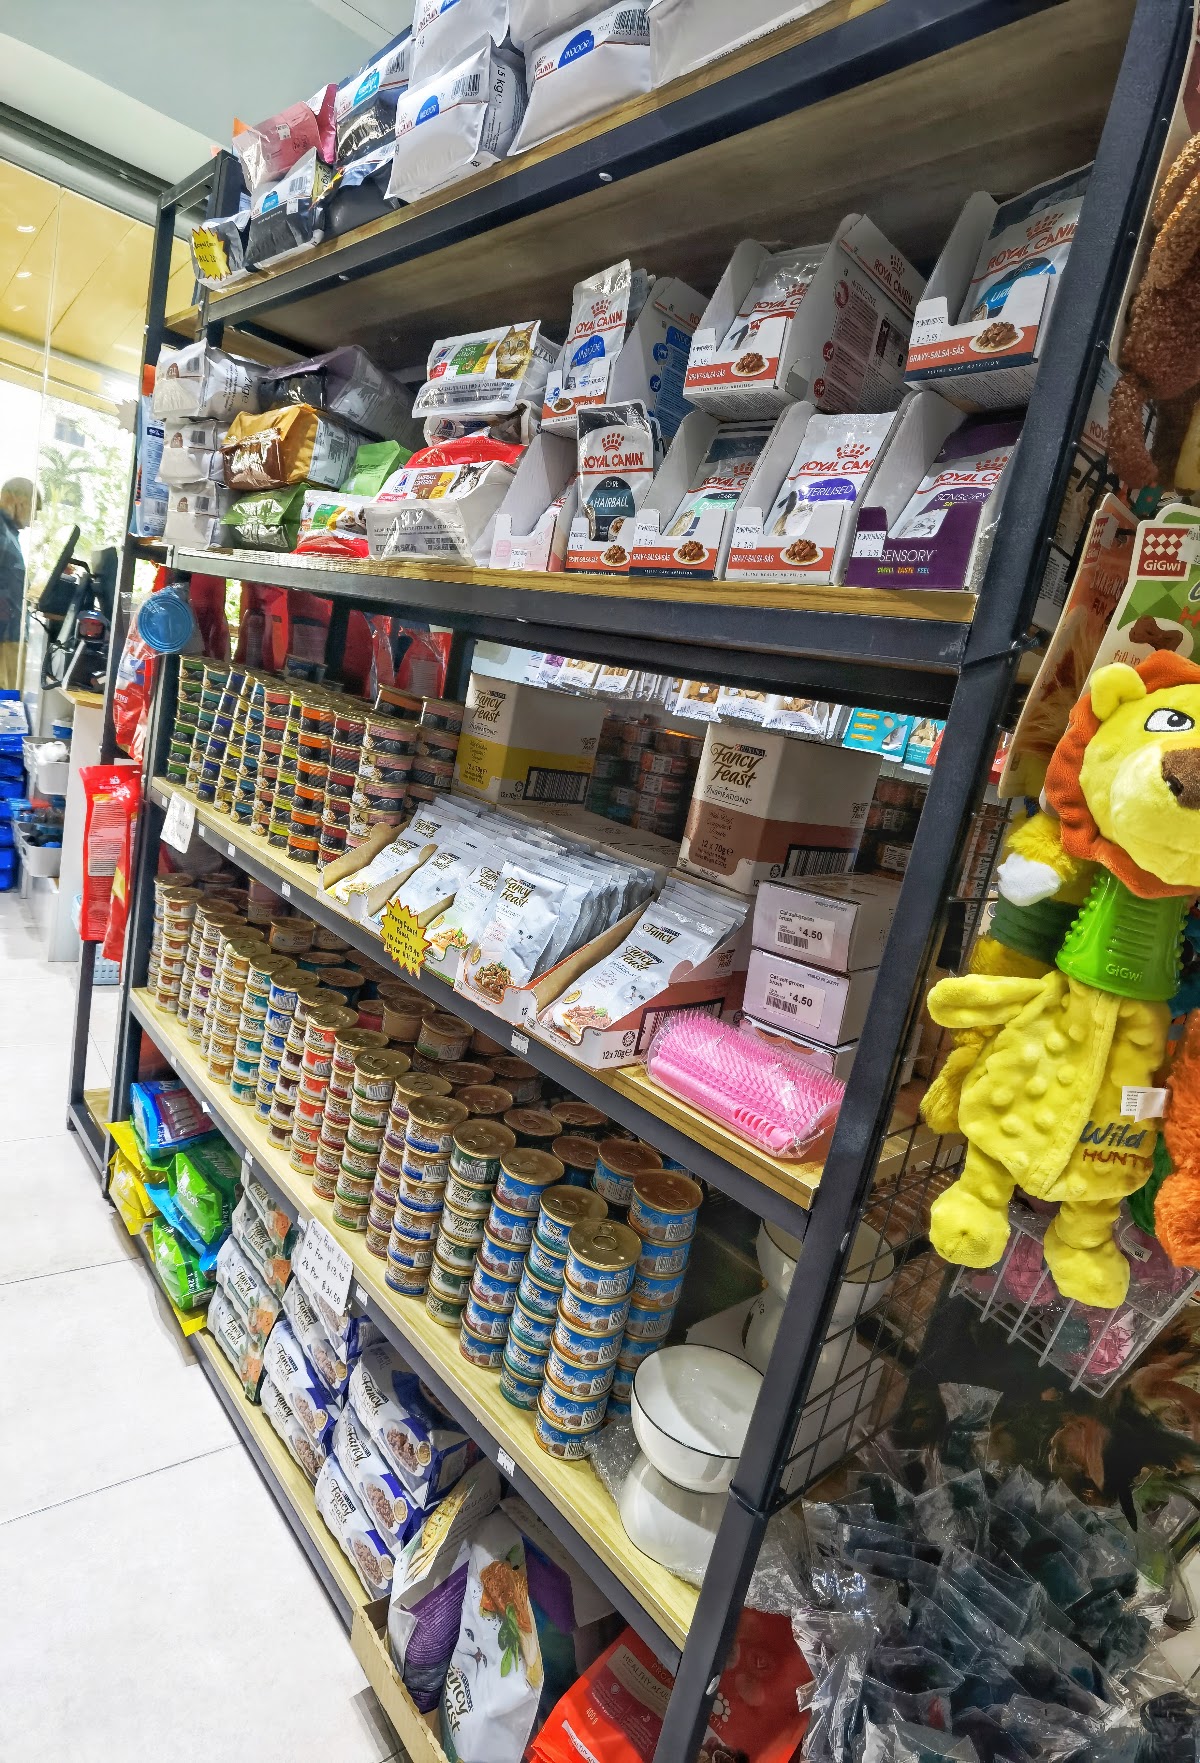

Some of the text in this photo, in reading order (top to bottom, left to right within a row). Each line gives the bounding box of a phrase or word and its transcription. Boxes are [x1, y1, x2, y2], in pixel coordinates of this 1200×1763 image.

[988, 243, 1030, 270] ROYAL
[874, 259, 892, 286] ROYAL
[991, 286, 1011, 303] LIGH
[753, 300, 788, 310] ROYAL
[597, 309, 624, 328] CANIN
[611, 451, 645, 468] CANIN
[801, 461, 838, 473] ROYAL
[934, 470, 979, 484] ROYAL
[803, 484, 853, 497] STERILISED
[593, 496, 629, 508] HAIRBALL
[879, 549, 934, 562] SENSORY
[897, 566, 914, 574] TASTE
[917, 566, 930, 574] FEEL
[1143, 559, 1181, 572] GiGwi
[1113, 650, 1129, 663] fill
[474, 689, 505, 712] Fancy
[472, 704, 501, 723] Feast
[710, 742, 765, 774] Fancy
[710, 762, 757, 788] Feast
[701, 839, 709, 848] 12
[505, 876, 535, 899] Fancy
[500, 887, 529, 908] Feast
[802, 928, 823, 941] 4.50
[618, 953, 650, 972] Feast
[625, 945, 660, 967] Fancy
[1105, 963, 1144, 982] GiGwi
[792, 993, 813, 1008] 4.50
[1080, 1120, 1148, 1149] Wild
[1082, 1148, 1154, 1169] HUNT
[451, 1190, 473, 1203] Feast
[452, 1180, 475, 1198] Fancy
[452, 1212, 479, 1229] Fancy
[454, 1222, 477, 1234] Feast
[237, 1266, 254, 1291] Fancy
[234, 1281, 248, 1300] Feast
[297, 1294, 315, 1326] Fancy
[226, 1313, 244, 1339] Fancy
[276, 1343, 294, 1375] Fancy
[362, 1371, 385, 1409] Fancy
[274, 1385, 294, 1418] Fancy
[346, 1423, 368, 1462] Fancy
[330, 1478, 352, 1517] Fancy
[622, 1653, 671, 1701] HEALTHY ADUL
